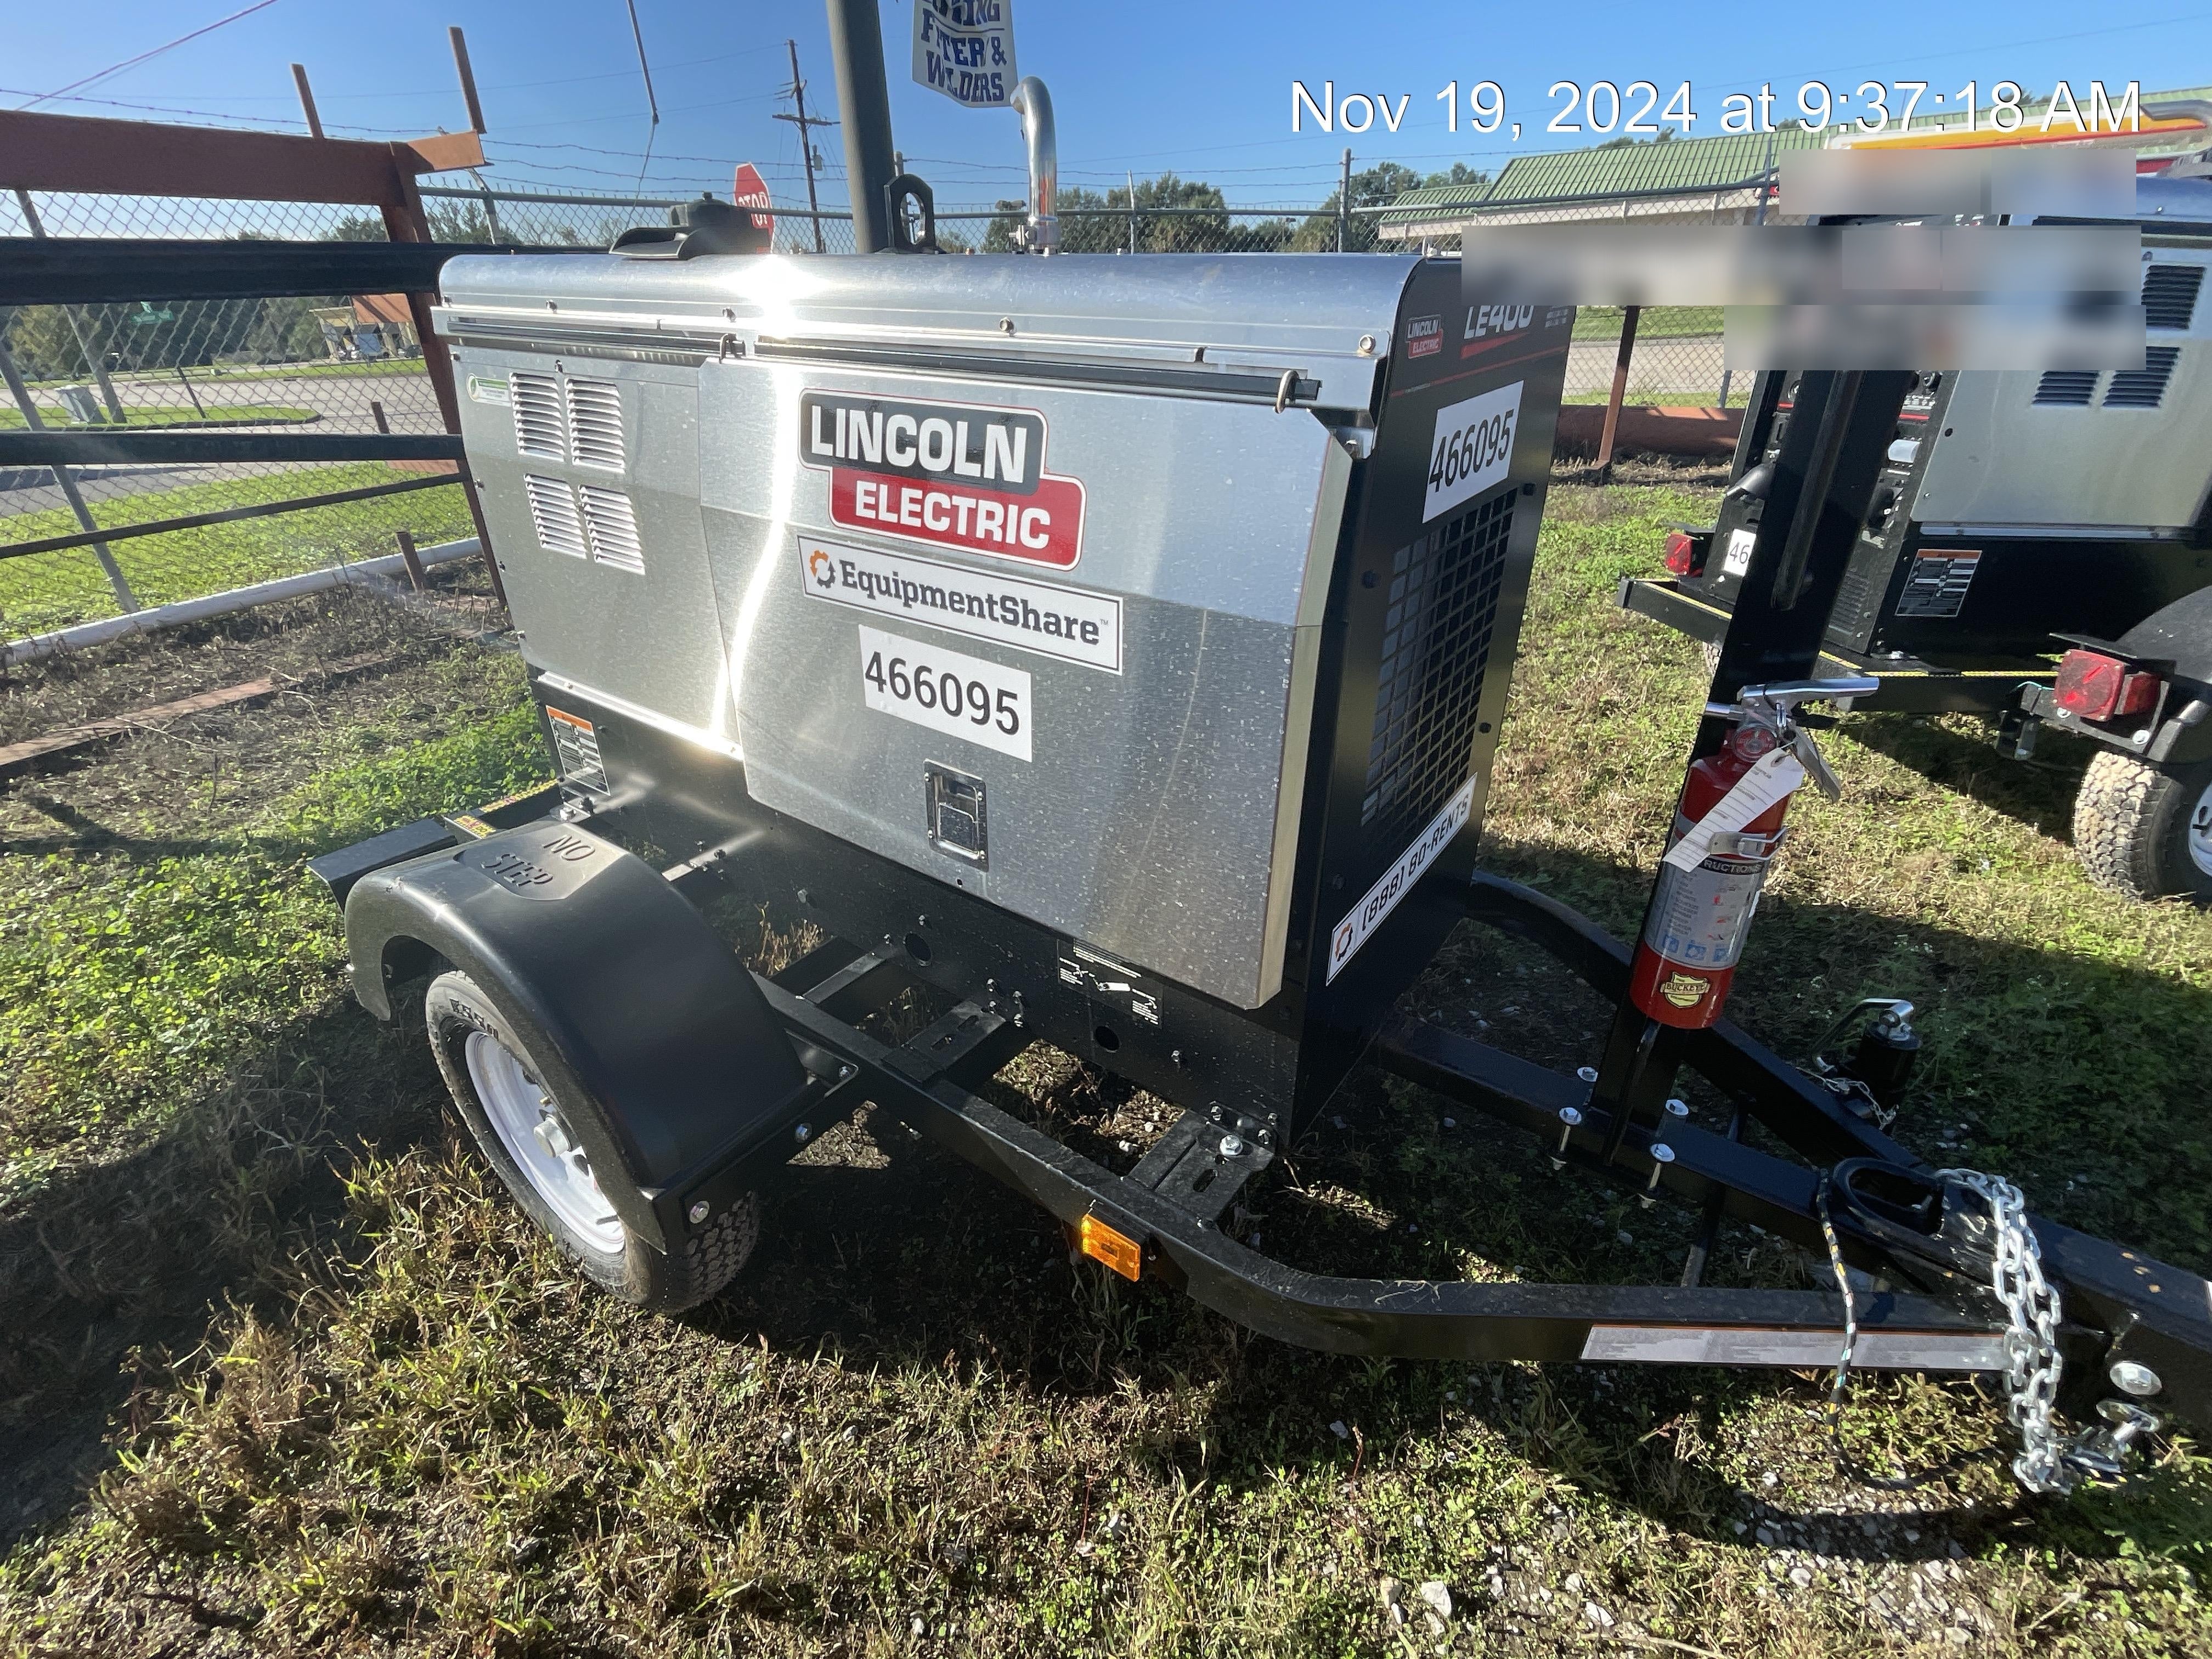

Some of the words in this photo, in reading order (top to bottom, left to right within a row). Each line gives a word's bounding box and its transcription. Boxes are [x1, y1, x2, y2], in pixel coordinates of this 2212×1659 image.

[991, 36, 1007, 66] &
[1407, 319, 1439, 338] LINCOLN
[1413, 338, 1440, 354] ELECTRIC
[1464, 306, 1534, 339] LE400
[811, 405, 1027, 484] LINCOLN
[1428, 409, 1514, 493] 466095
[855, 479, 1051, 549] ELECTRIC
[839, 559, 1099, 646] EquipmentShare
[865, 651, 1019, 735] 466095
[481, 853, 554, 887] STEP
[541, 834, 596, 861] NO
[1361, 865, 1405, 932] (888)
[1408, 793, 1470, 877] 80-RENTS
